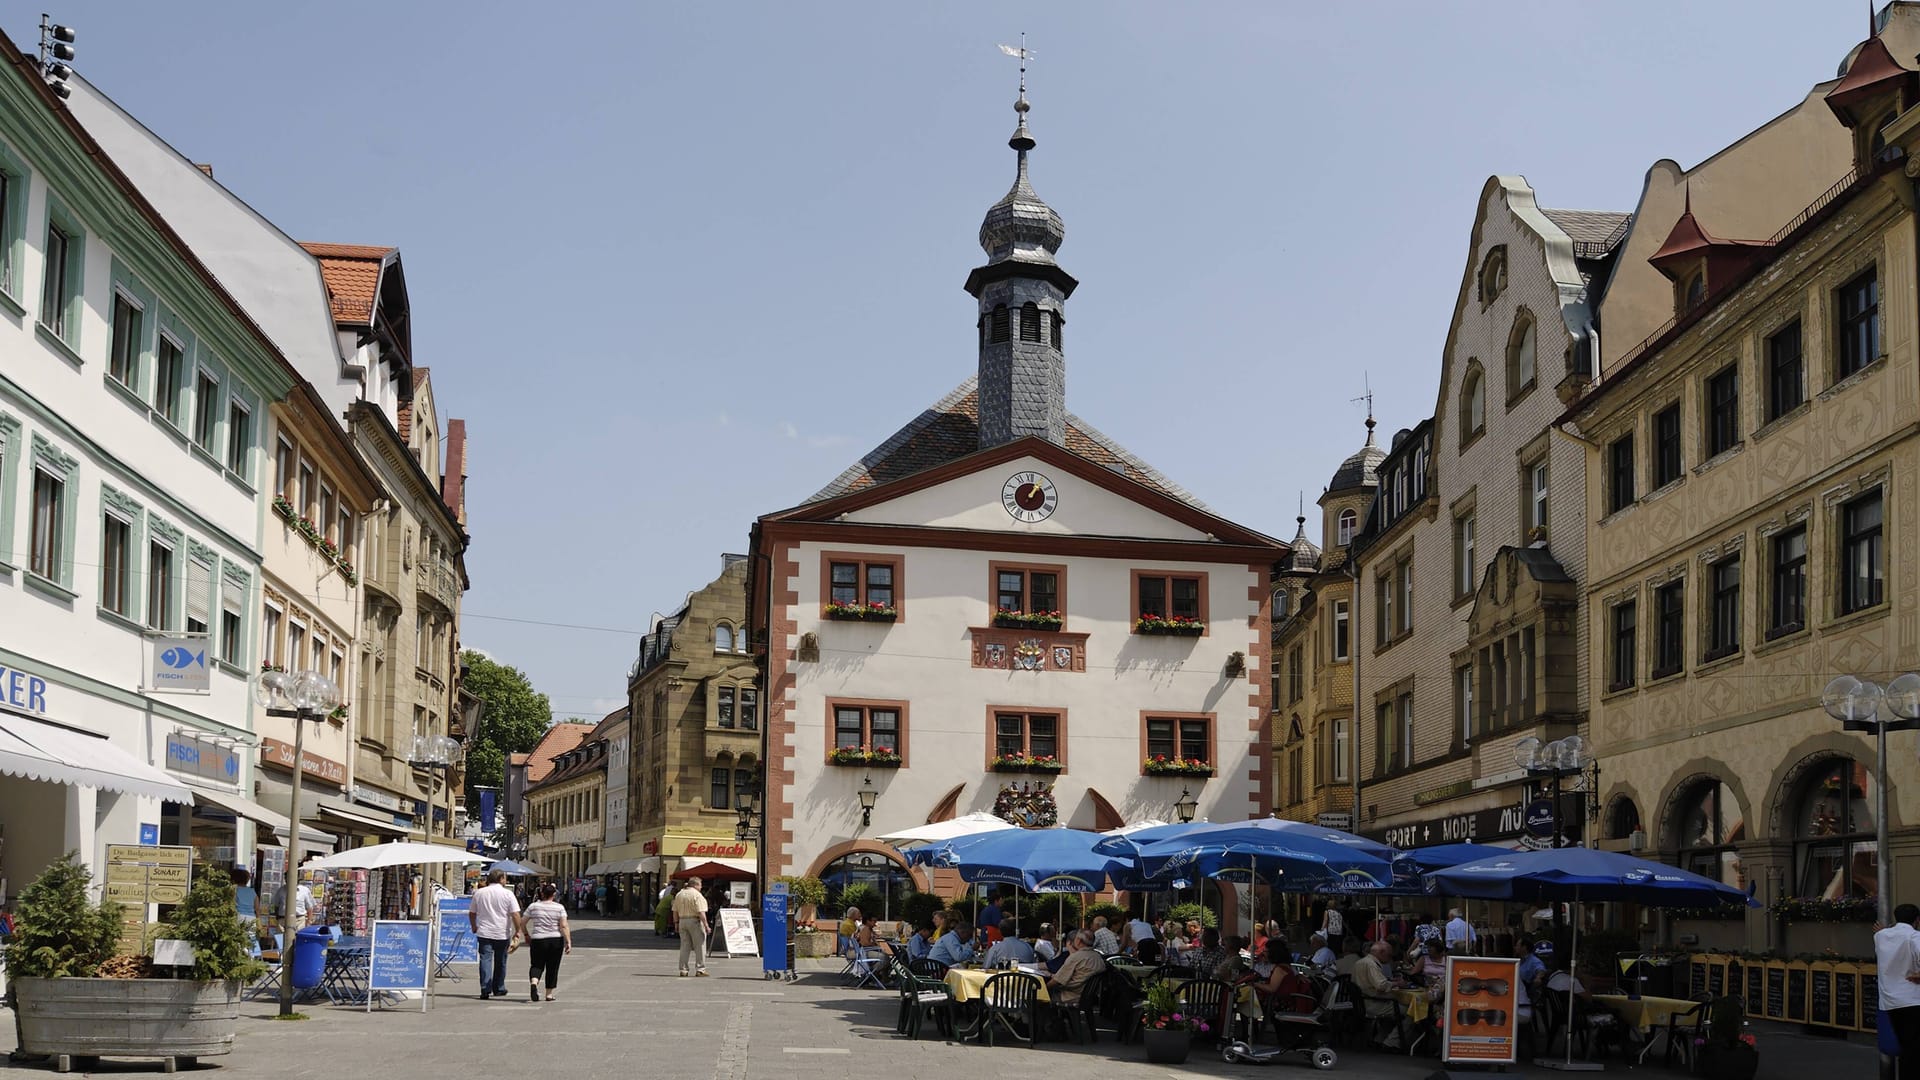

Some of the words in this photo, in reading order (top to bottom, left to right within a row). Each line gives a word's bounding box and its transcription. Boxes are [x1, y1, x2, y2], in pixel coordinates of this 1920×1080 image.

[1386, 825, 1417, 847] SPORT
[1443, 814, 1477, 840] MODE
[687, 841, 744, 856] Gerlach
